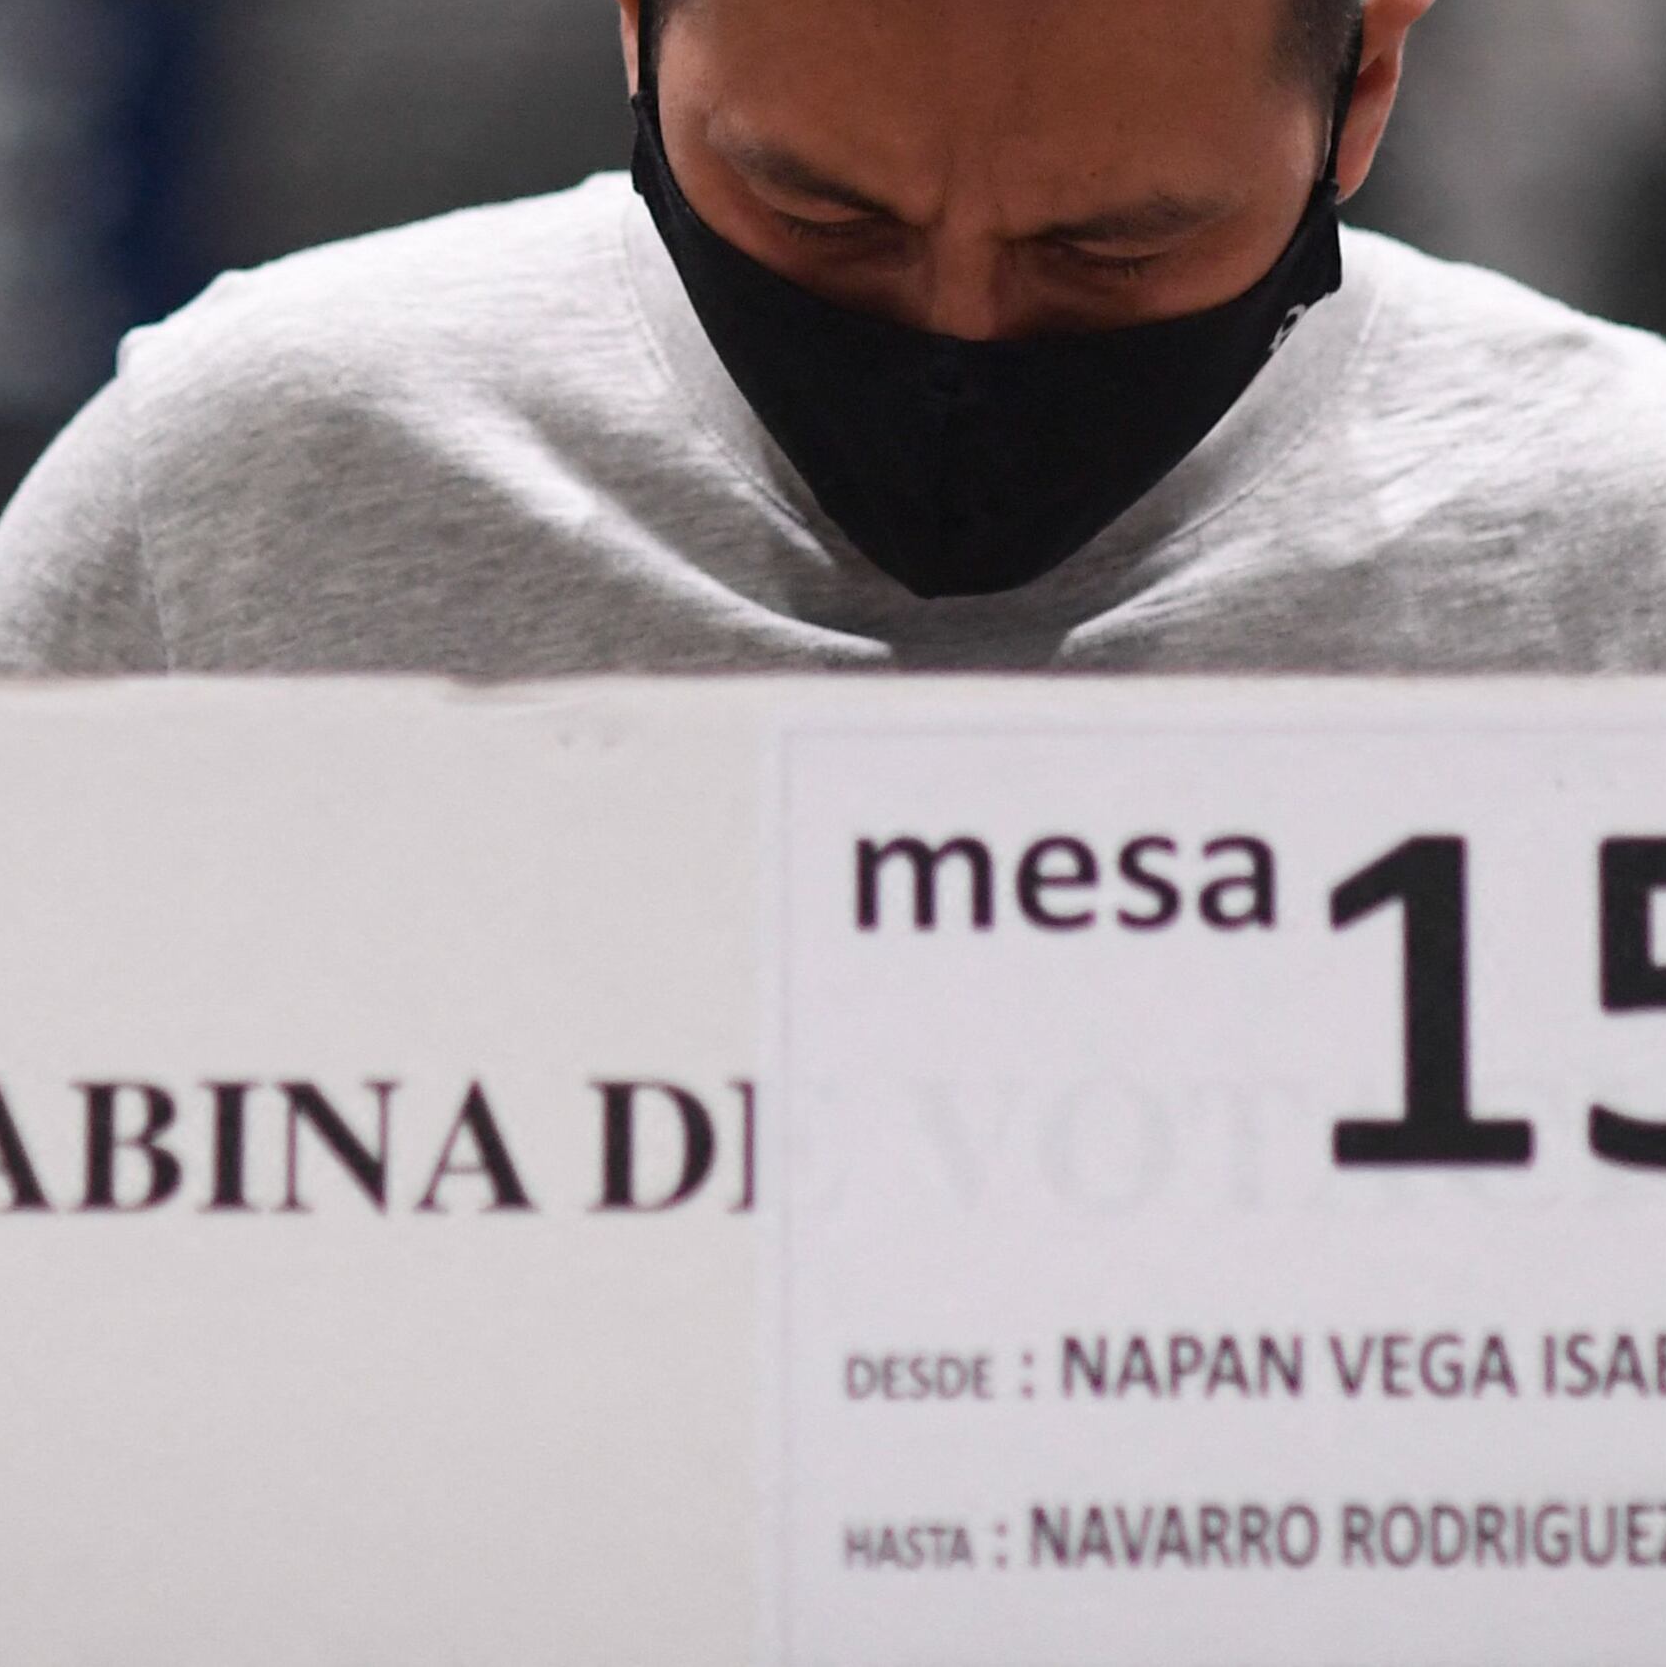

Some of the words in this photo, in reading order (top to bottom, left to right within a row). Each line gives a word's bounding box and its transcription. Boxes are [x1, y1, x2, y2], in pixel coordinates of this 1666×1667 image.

[854, 834, 1278, 933] mesa
[844, 1353, 992, 1400] DESDE
[1060, 1331, 1305, 1399] NAPAN
[1327, 1331, 1521, 1399] VEGA
[843, 1522, 975, 1570] HASTA
[1028, 1500, 1322, 1570] NAVARRO
